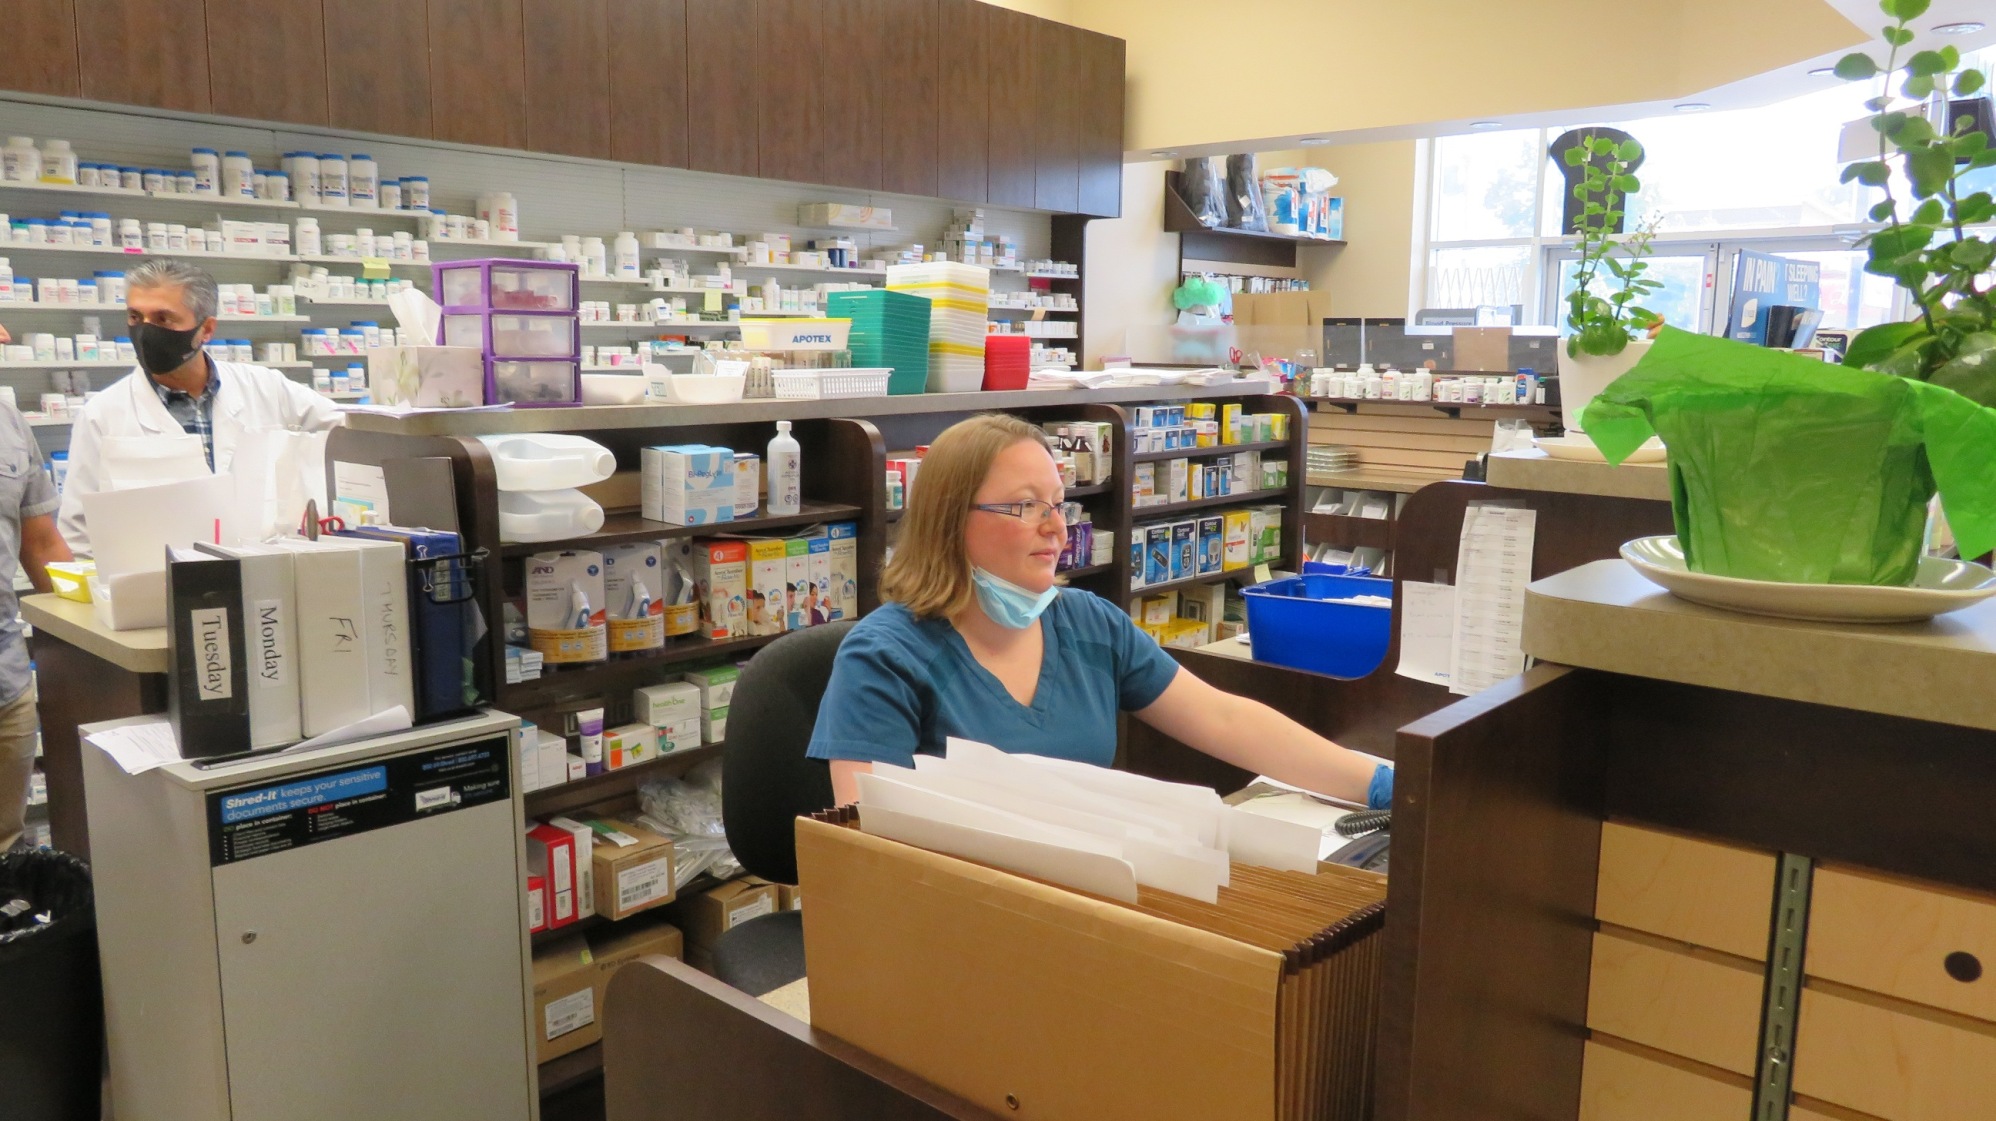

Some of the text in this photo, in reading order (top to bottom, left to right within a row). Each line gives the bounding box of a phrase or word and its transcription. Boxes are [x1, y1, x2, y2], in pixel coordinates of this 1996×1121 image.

[1743, 257, 1756, 292] IN
[1788, 264, 1819, 283] SLEEPING
[1787, 283, 1809, 301] WELL?
[792, 334, 832, 343] APOTEX
[260, 606, 282, 680] Monday
[329, 617, 358, 652] FRI
[380, 581, 398, 675] THURSDAY
[202, 615, 227, 693] Tuesday
[226, 771, 381, 809] Shred-it keeps your sensitive
[227, 794, 326, 820] documents secure.
